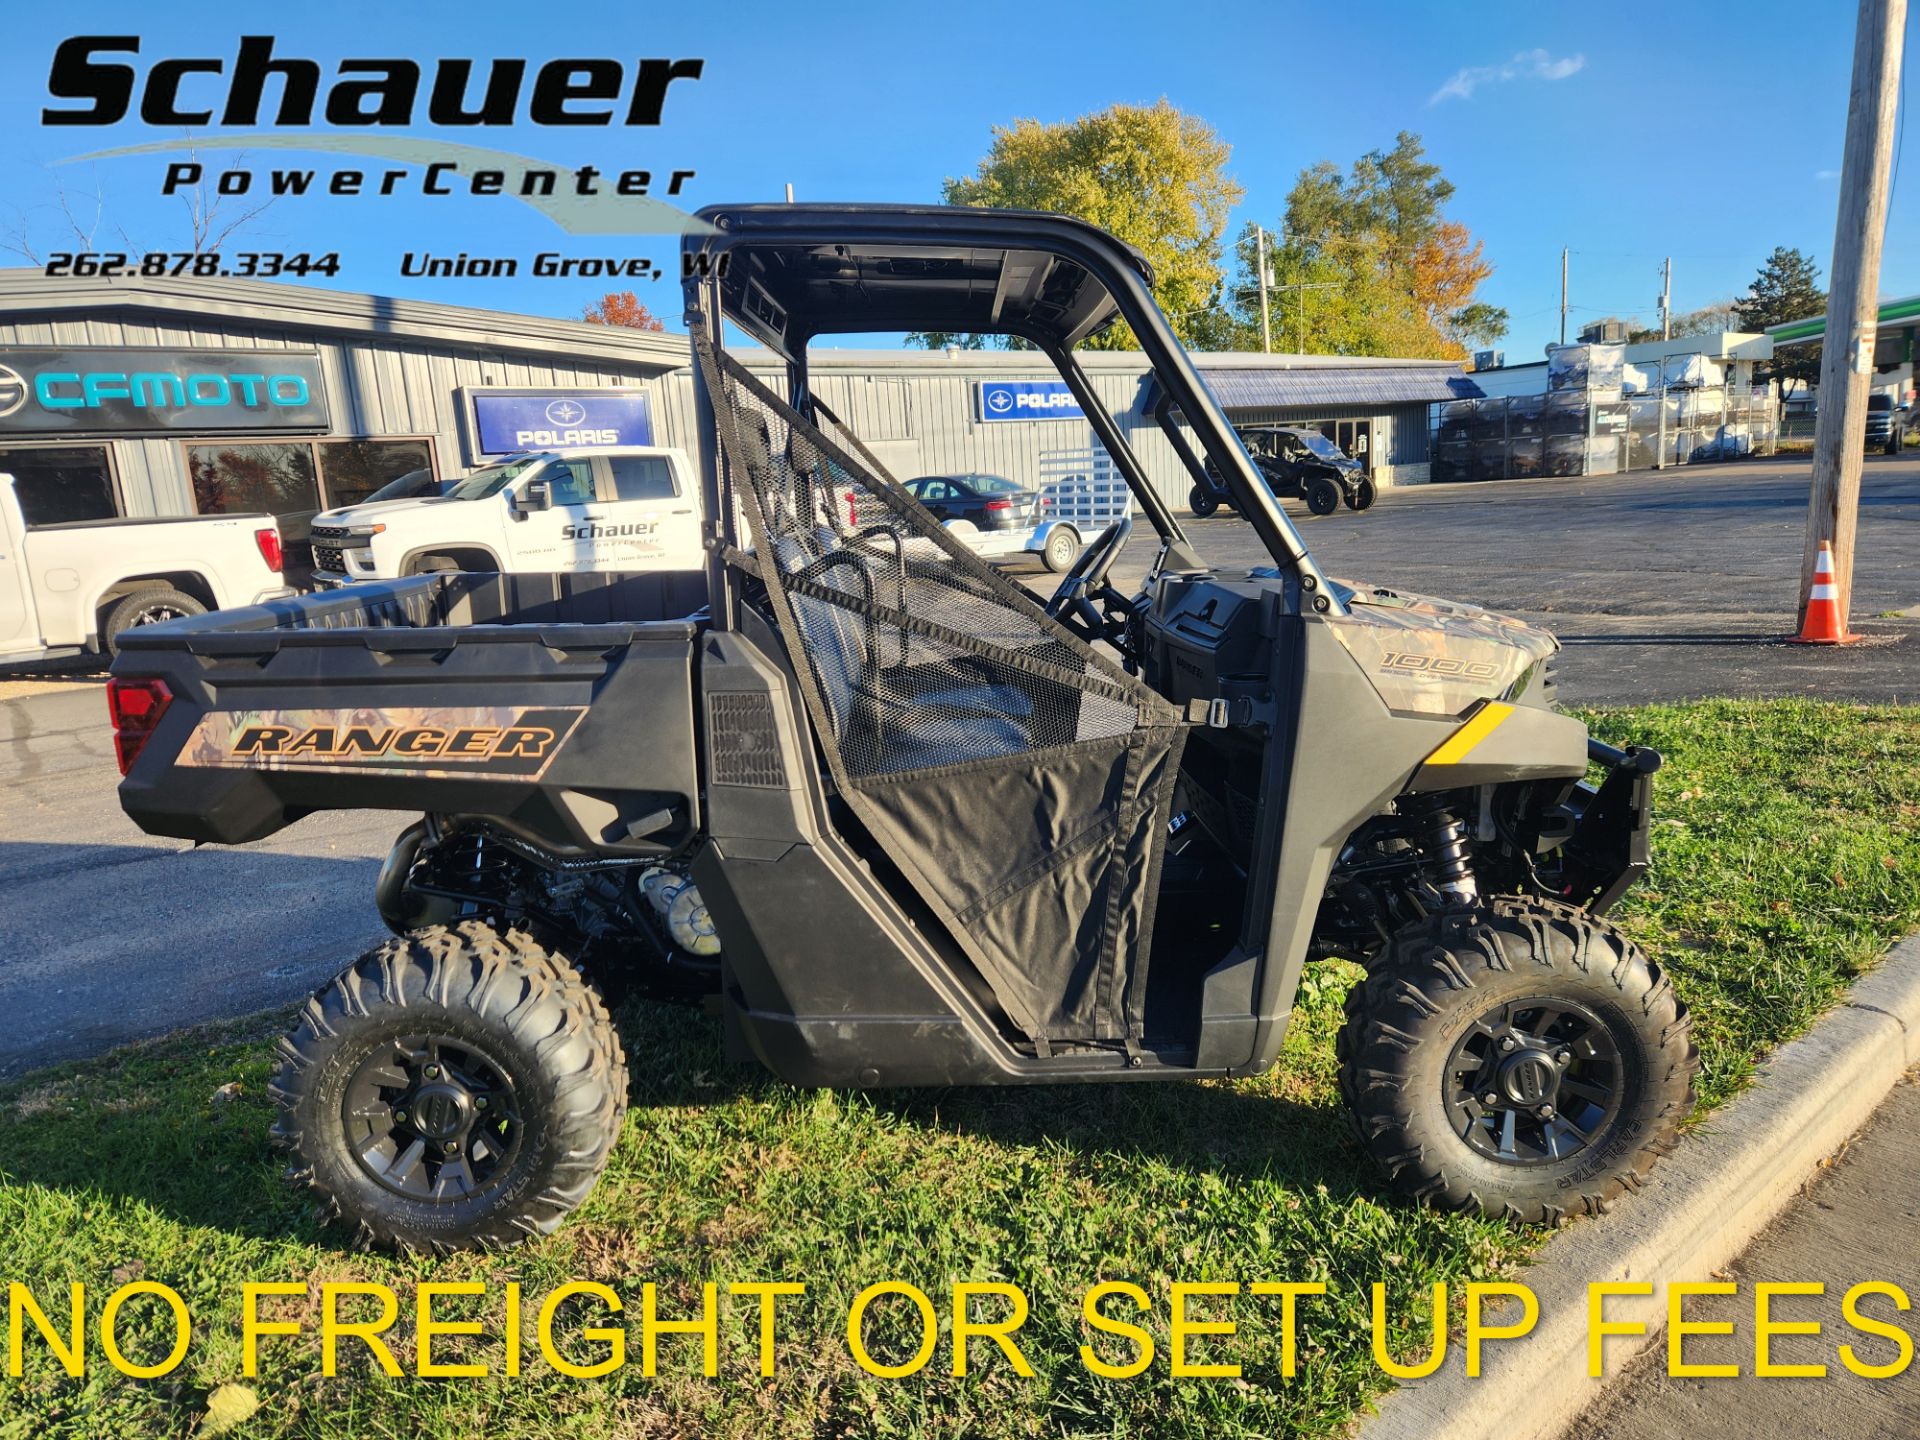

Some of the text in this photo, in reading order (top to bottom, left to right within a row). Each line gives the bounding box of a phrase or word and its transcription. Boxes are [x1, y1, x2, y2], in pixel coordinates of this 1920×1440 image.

[34, 372, 310, 407] CFMOTO
[1016, 393, 1080, 409] POLARI
[516, 429, 620, 446] POLARIS
[561, 522, 659, 541] Schauer
[1380, 651, 1500, 679] 1000
[231, 725, 555, 757] RANGER
